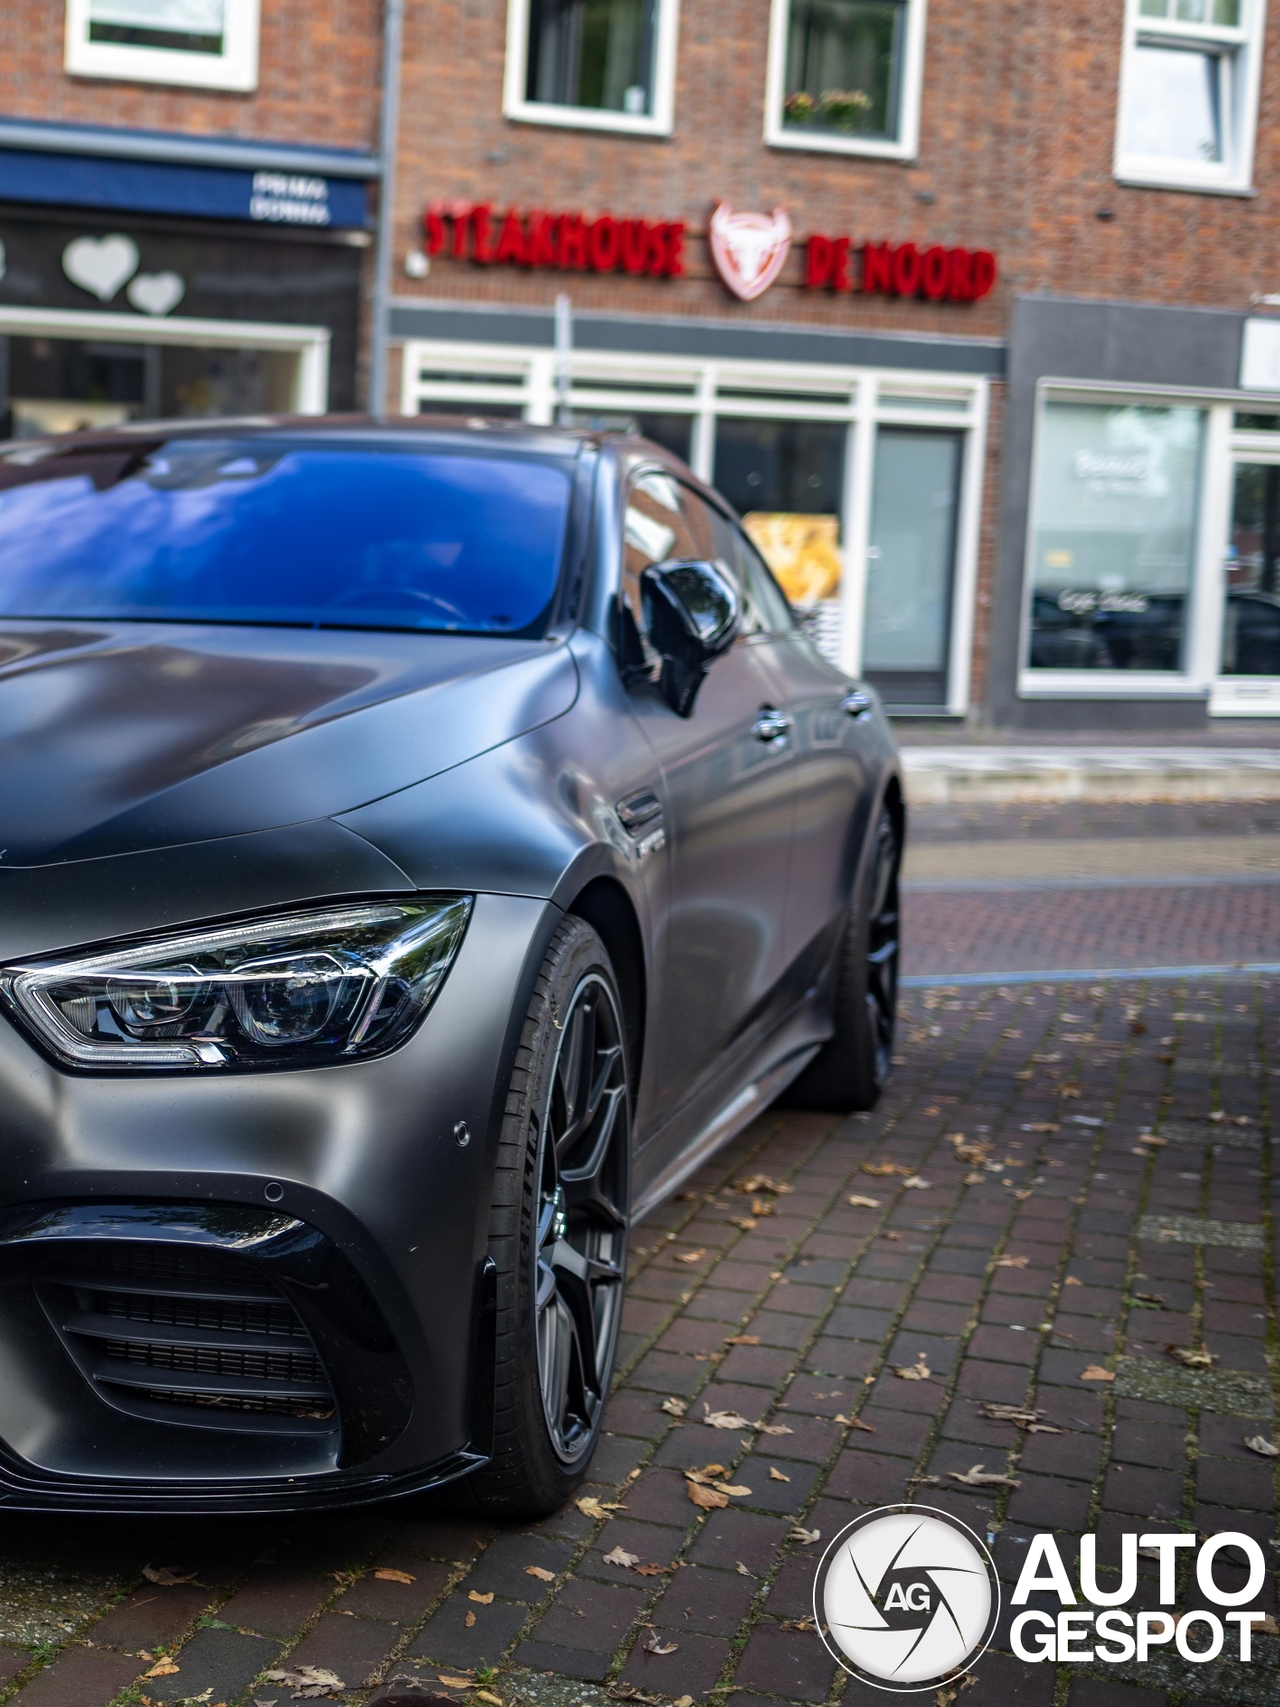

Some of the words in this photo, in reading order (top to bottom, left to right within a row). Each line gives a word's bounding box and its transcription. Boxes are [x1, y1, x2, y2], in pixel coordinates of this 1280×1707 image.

[425, 199, 686, 277] STEAKHOUSE
[806, 236, 850, 291] DE
[862, 241, 996, 299] NOORD
[518, 1123, 538, 1310] MICHELIN
